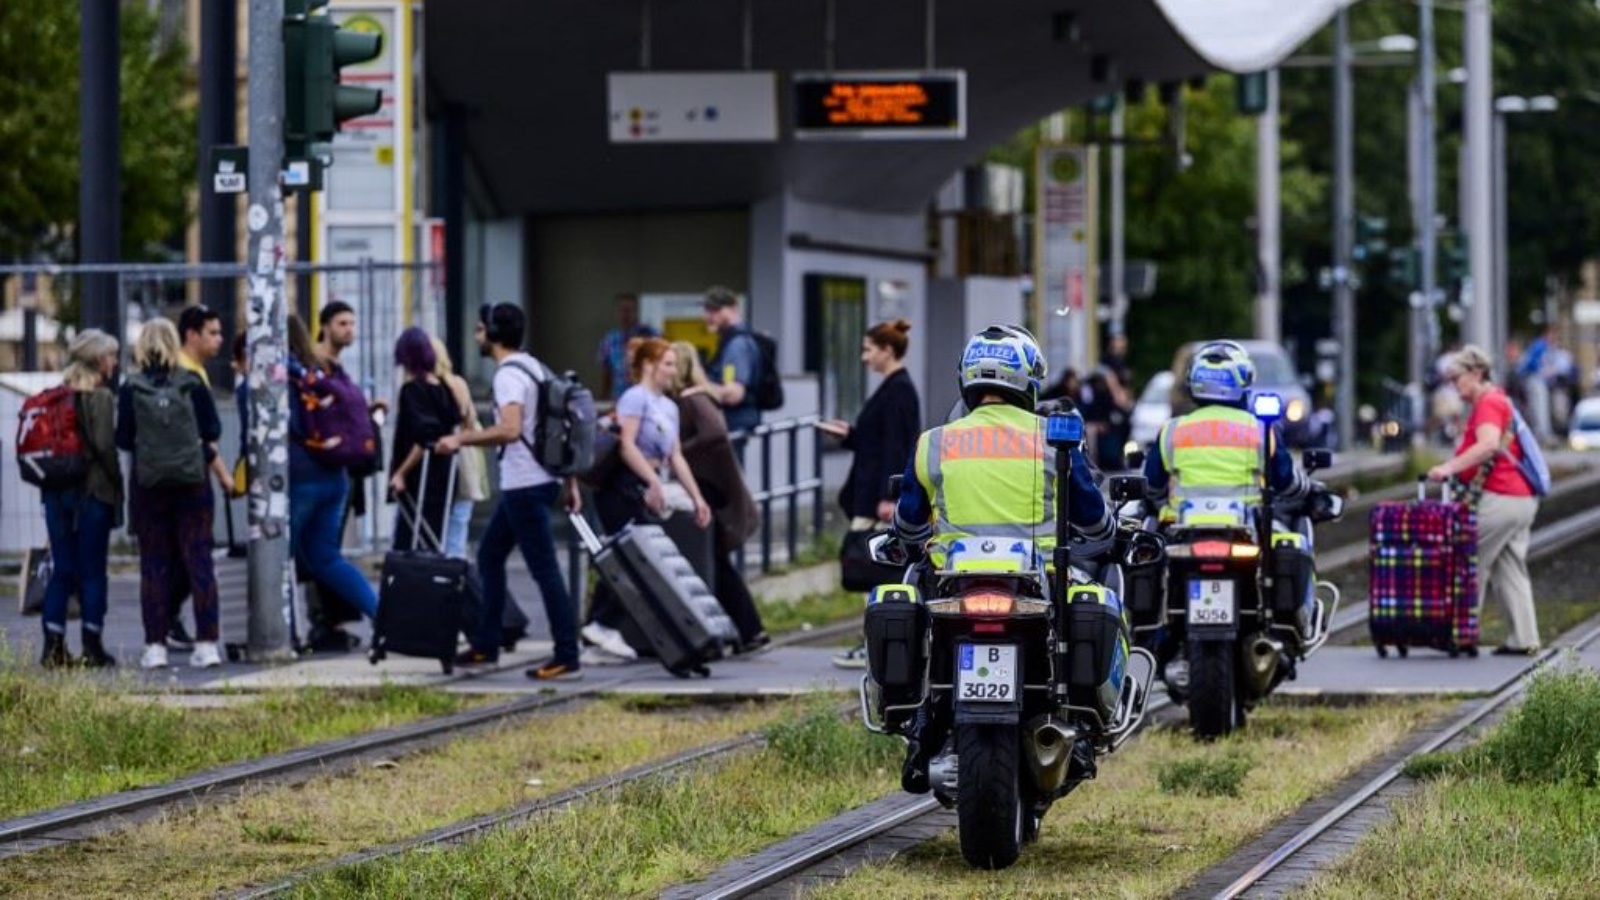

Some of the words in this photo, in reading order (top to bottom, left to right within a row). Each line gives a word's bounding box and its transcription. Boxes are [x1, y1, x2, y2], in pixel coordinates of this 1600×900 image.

[969, 345, 1016, 360] POLIZEI
[988, 647, 999, 662] B
[963, 682, 1010, 698] 3029
